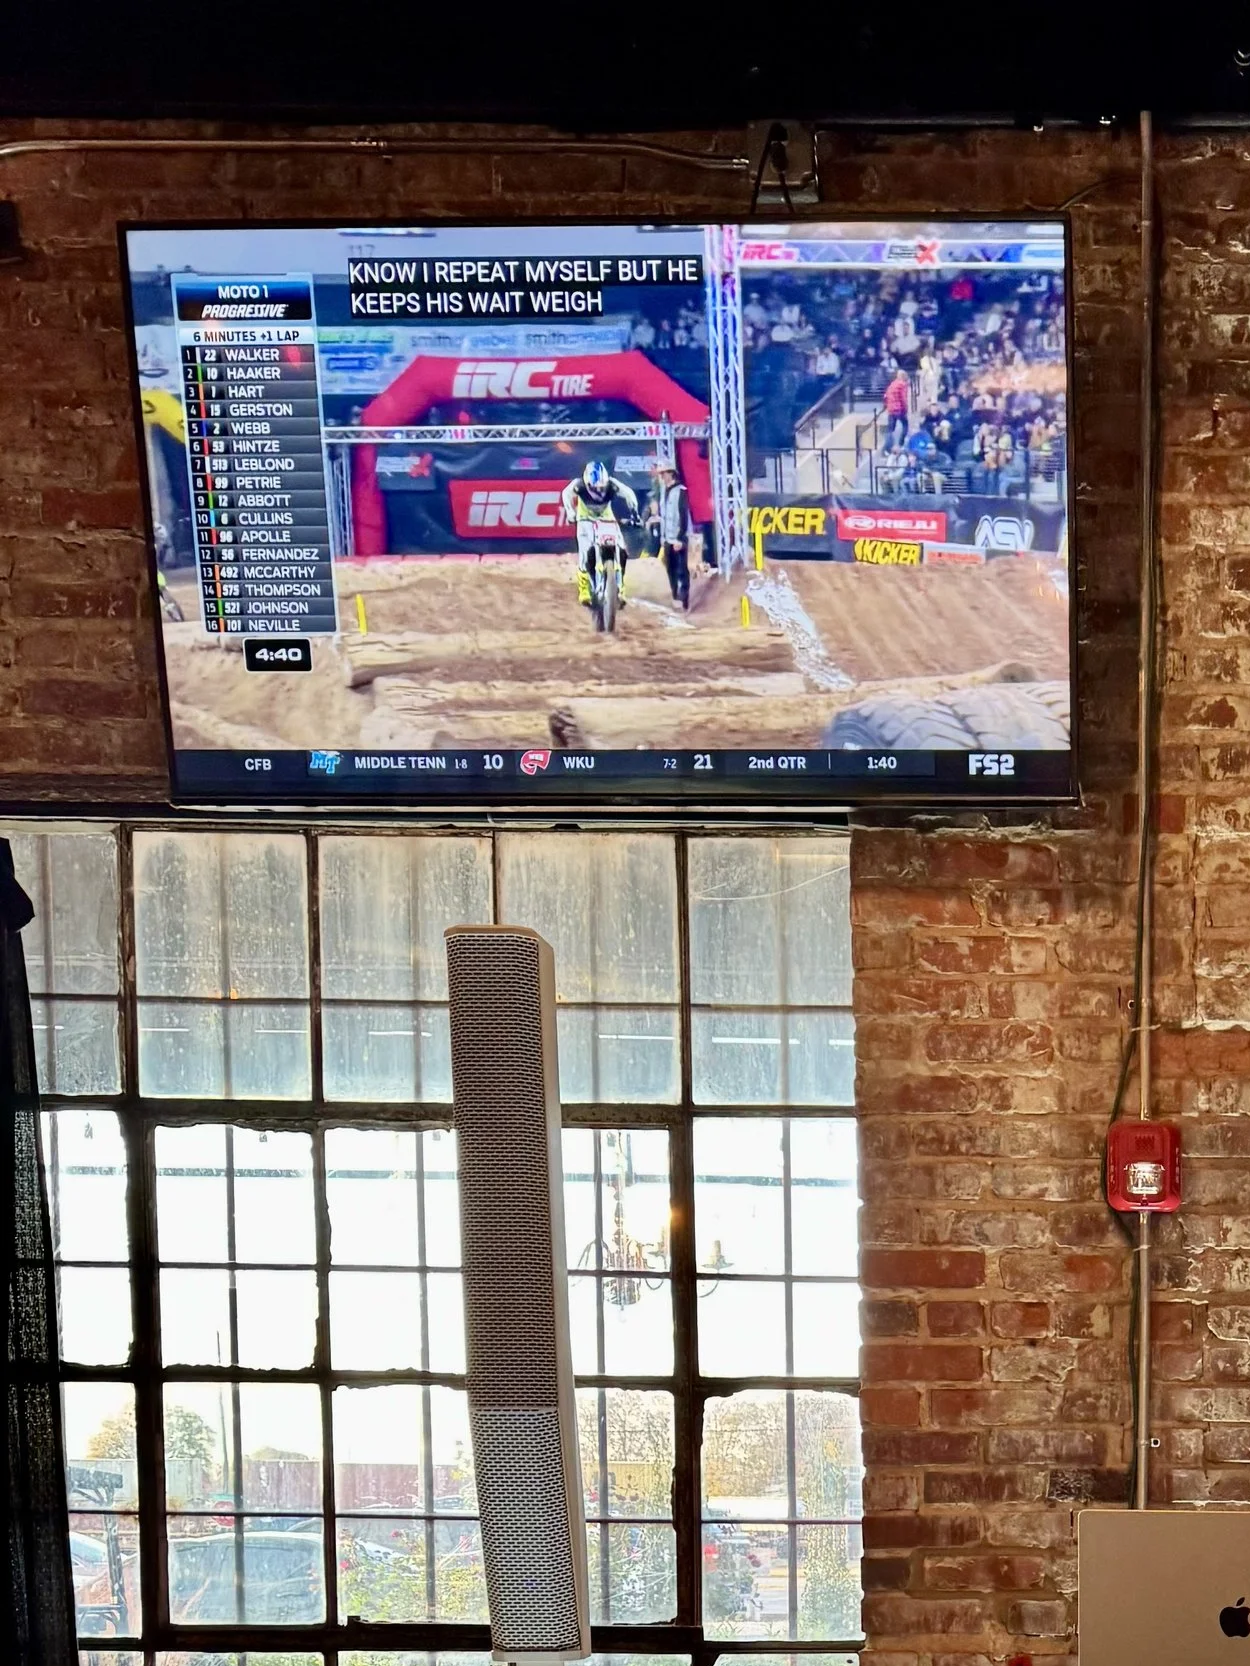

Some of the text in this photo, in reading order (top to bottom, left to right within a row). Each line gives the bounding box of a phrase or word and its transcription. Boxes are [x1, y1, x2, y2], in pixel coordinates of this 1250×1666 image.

[350, 260, 698, 284] KNOW I REPEAT MYSELF BUT HE
[218, 285, 269, 299] MOTO 1
[351, 291, 603, 313] KEEPS HIS WAIT WEIGH
[202, 304, 287, 318] PROGRESSIVE
[194, 331, 300, 342] 6 MINUTES +1 LAP
[186, 349, 280, 361] 1 22 WALKER
[187, 367, 281, 379] 2 10 HAAKER
[551, 374, 594, 396] TIRE
[189, 385, 264, 398] 3 1 HART
[190, 405, 196, 415] 4
[229, 404, 293, 416] GERSTON
[192, 422, 270, 434] 5 2 WEBB
[193, 442, 200, 451] 6
[233, 440, 280, 452] HINTZE
[195, 458, 295, 471] 7 513 LEBLOND
[197, 478, 203, 488] 8
[236, 476, 281, 488] PETRIE
[198, 495, 291, 507] 9 12 ABBOTT
[197, 514, 208, 524] 10
[239, 512, 293, 524] CULLINS
[201, 531, 208, 541] 11
[241, 531, 290, 542] APOLLE
[201, 549, 211, 560] 12
[243, 549, 320, 560] FERNANDEZ
[862, 539, 920, 567] KICKER
[203, 566, 316, 578] 13 492 MCCARTHY
[204, 584, 321, 596] 14 575 THOMPSON
[206, 602, 216, 613] 15
[247, 602, 309, 614] JOHNSON
[207, 619, 300, 631] 16 101 NEVILLE
[256, 648, 302, 661] 4:40
[244, 758, 271, 771] CFB
[354, 757, 406, 769] MIDDLE
[408, 757, 446, 769] TENN
[483, 754, 503, 769] 10
[563, 754, 713, 770] WKU 7-2 21
[749, 756, 897, 770] 2nd QTR 1:40
[968, 754, 1015, 775] FS2
